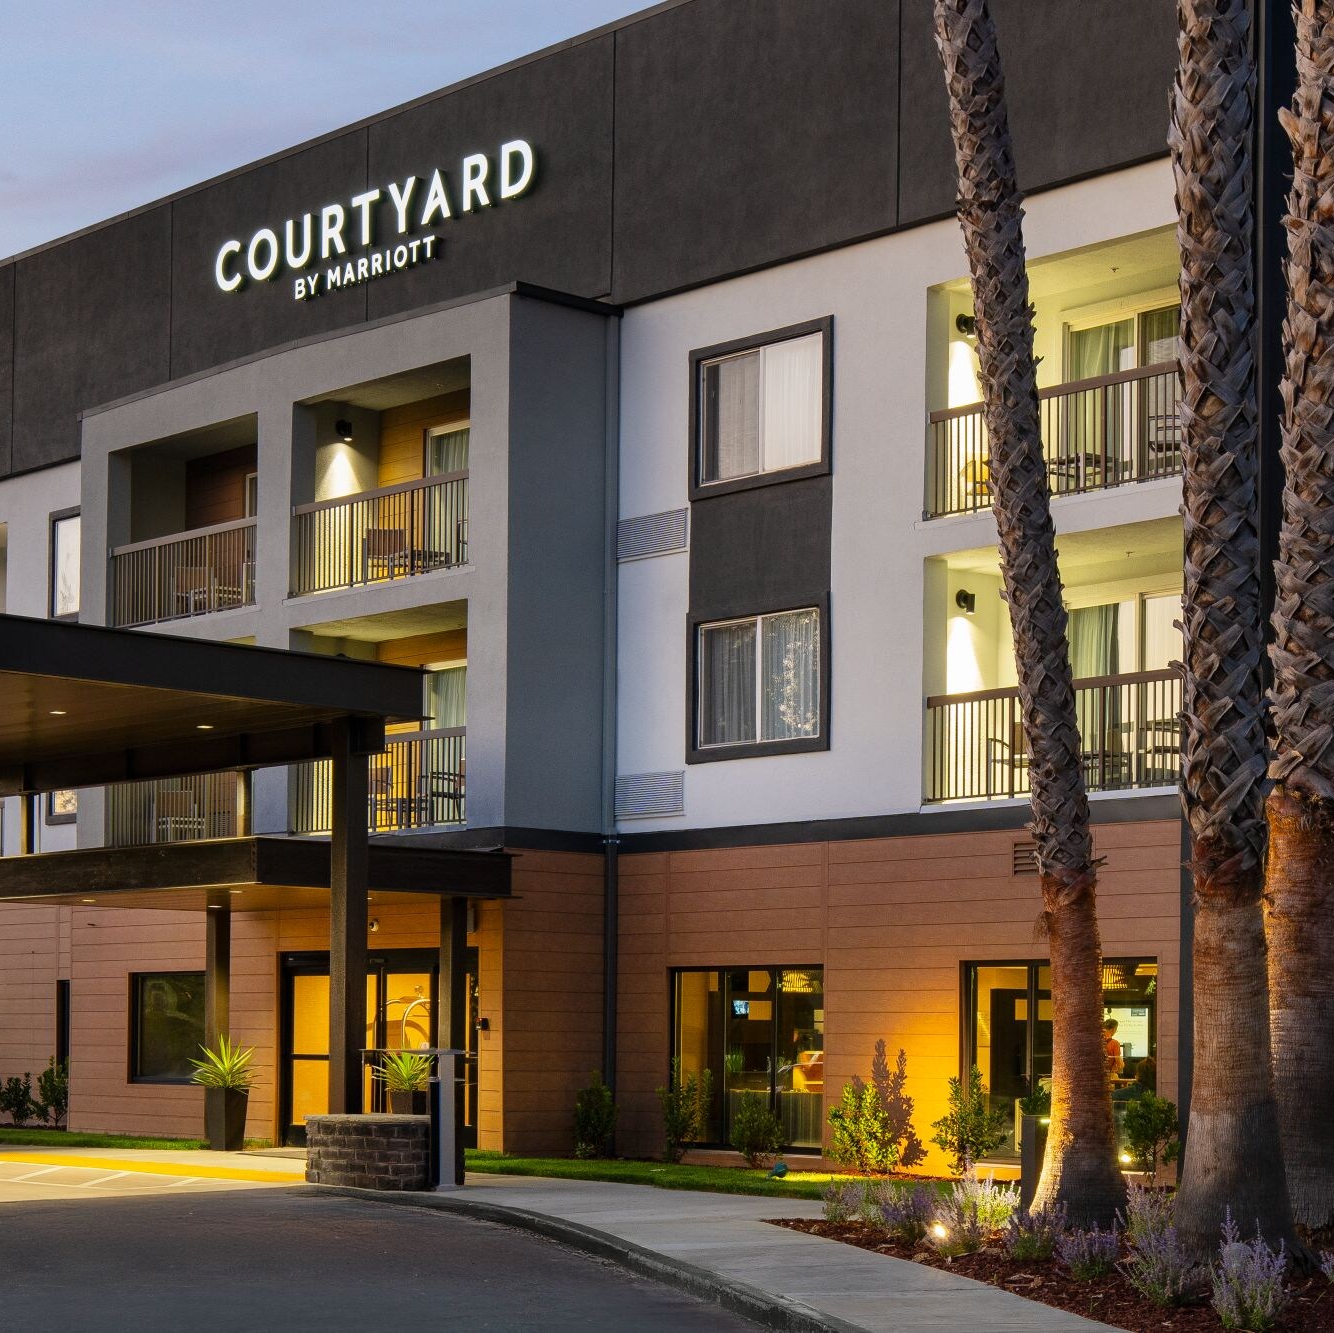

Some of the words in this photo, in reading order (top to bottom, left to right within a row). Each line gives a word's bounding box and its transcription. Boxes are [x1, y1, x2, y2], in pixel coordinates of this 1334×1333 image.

[214, 139, 534, 292] COURTYARD
[294, 272, 320, 300] BY
[326, 234, 437, 290] MARRIOTT
